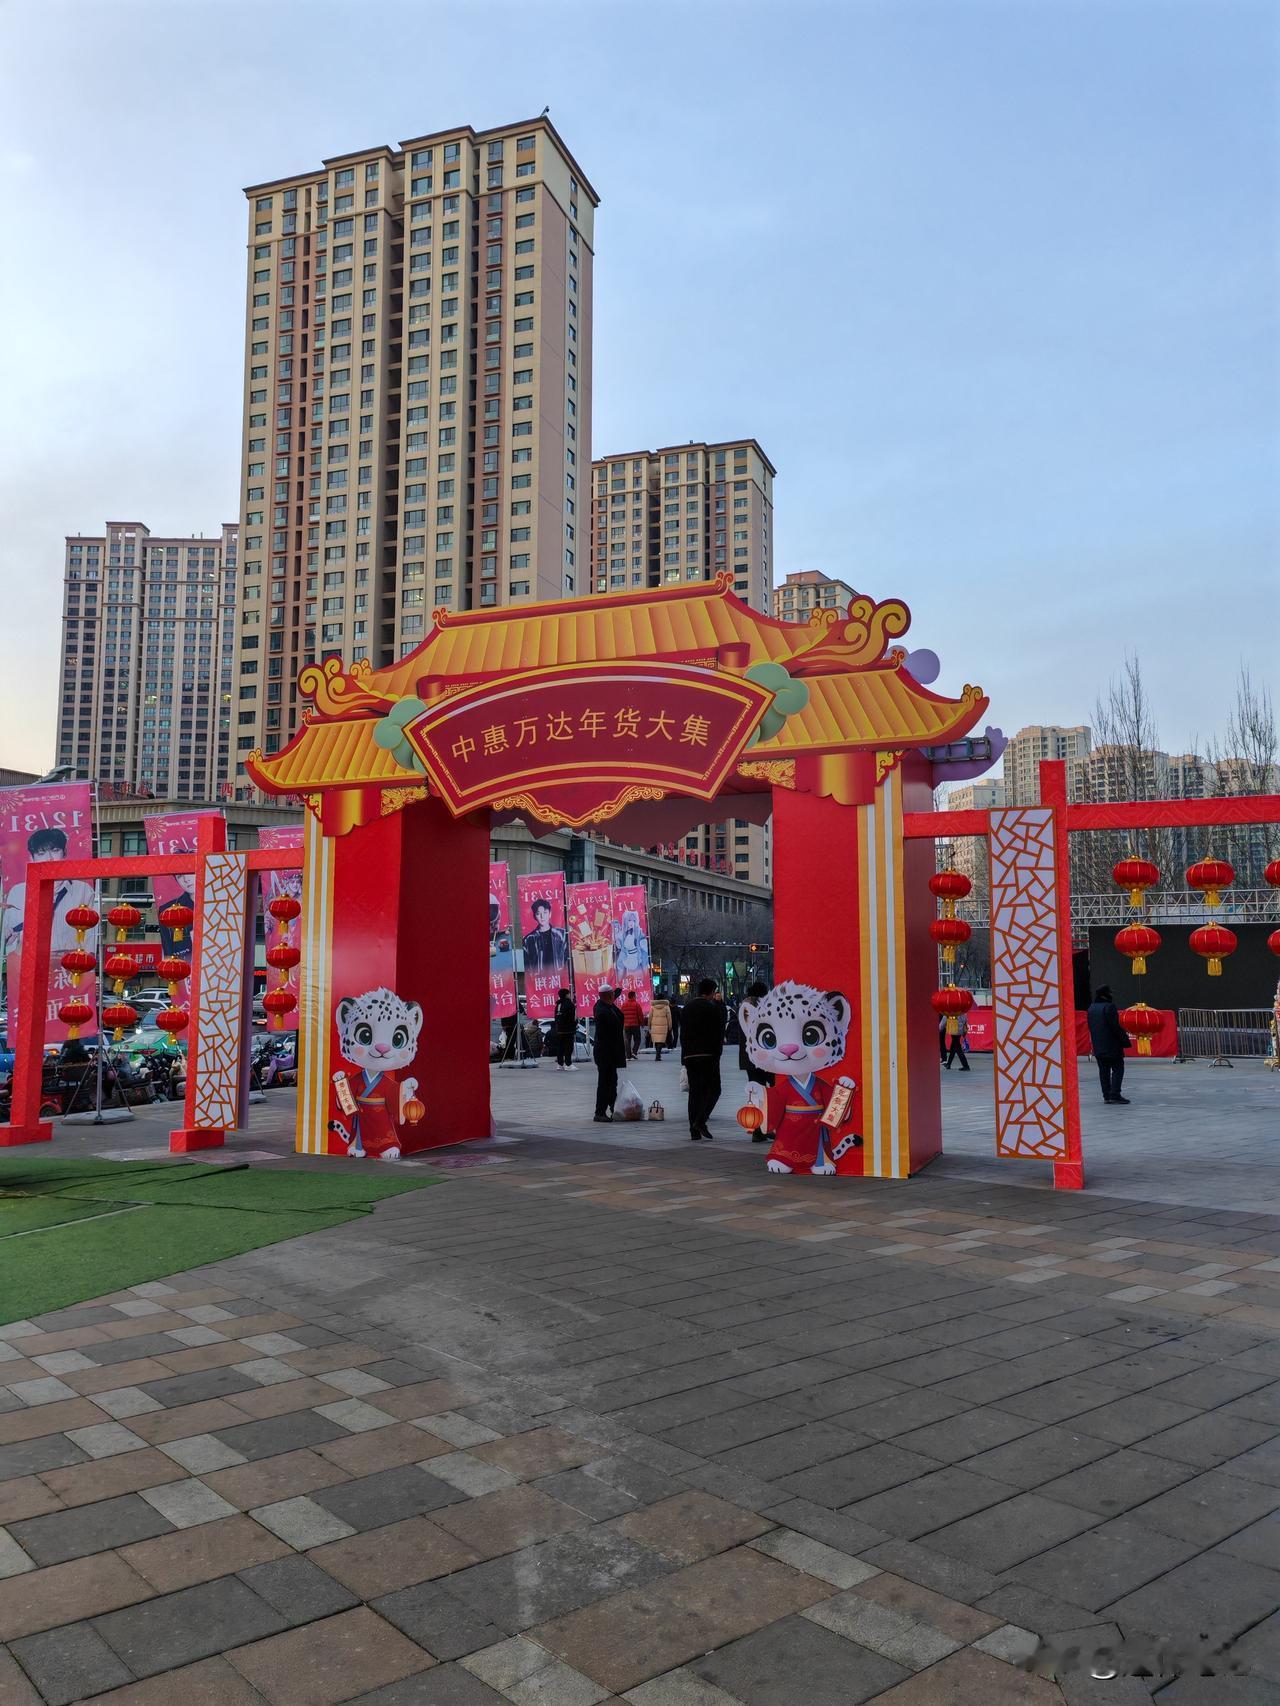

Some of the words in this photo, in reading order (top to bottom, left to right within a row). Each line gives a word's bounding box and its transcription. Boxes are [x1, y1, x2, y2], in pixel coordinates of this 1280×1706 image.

[451, 708, 712, 764] 中惠万达年货大集
